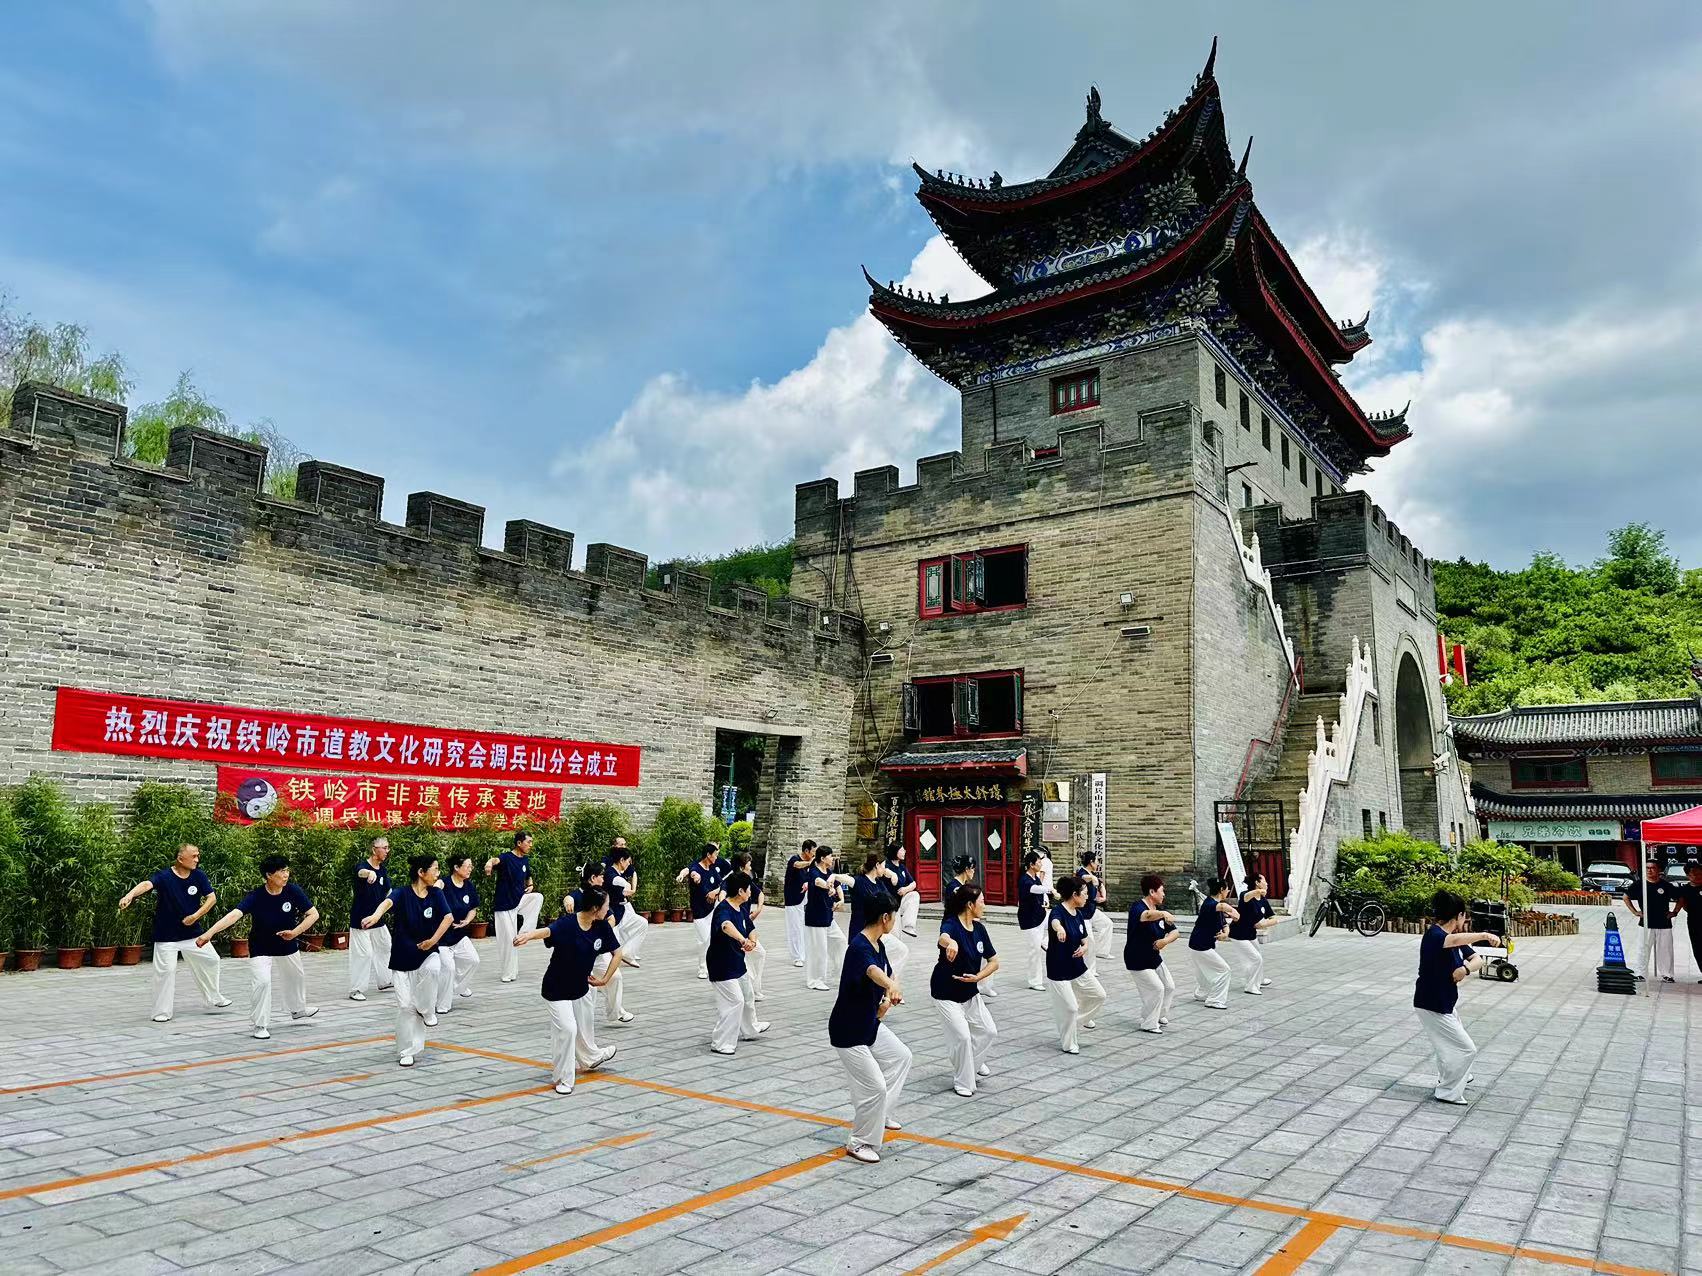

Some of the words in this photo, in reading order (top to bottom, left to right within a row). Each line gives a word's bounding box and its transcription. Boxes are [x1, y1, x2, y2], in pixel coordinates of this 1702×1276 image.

[103, 704, 618, 778] 热烈庆祝铁岭市道教文化研究会调兵山分会成立
[287, 776, 548, 811] 铁岭市非遗传承基地
[1522, 825, 1582, 838] 兄弟冷饮
